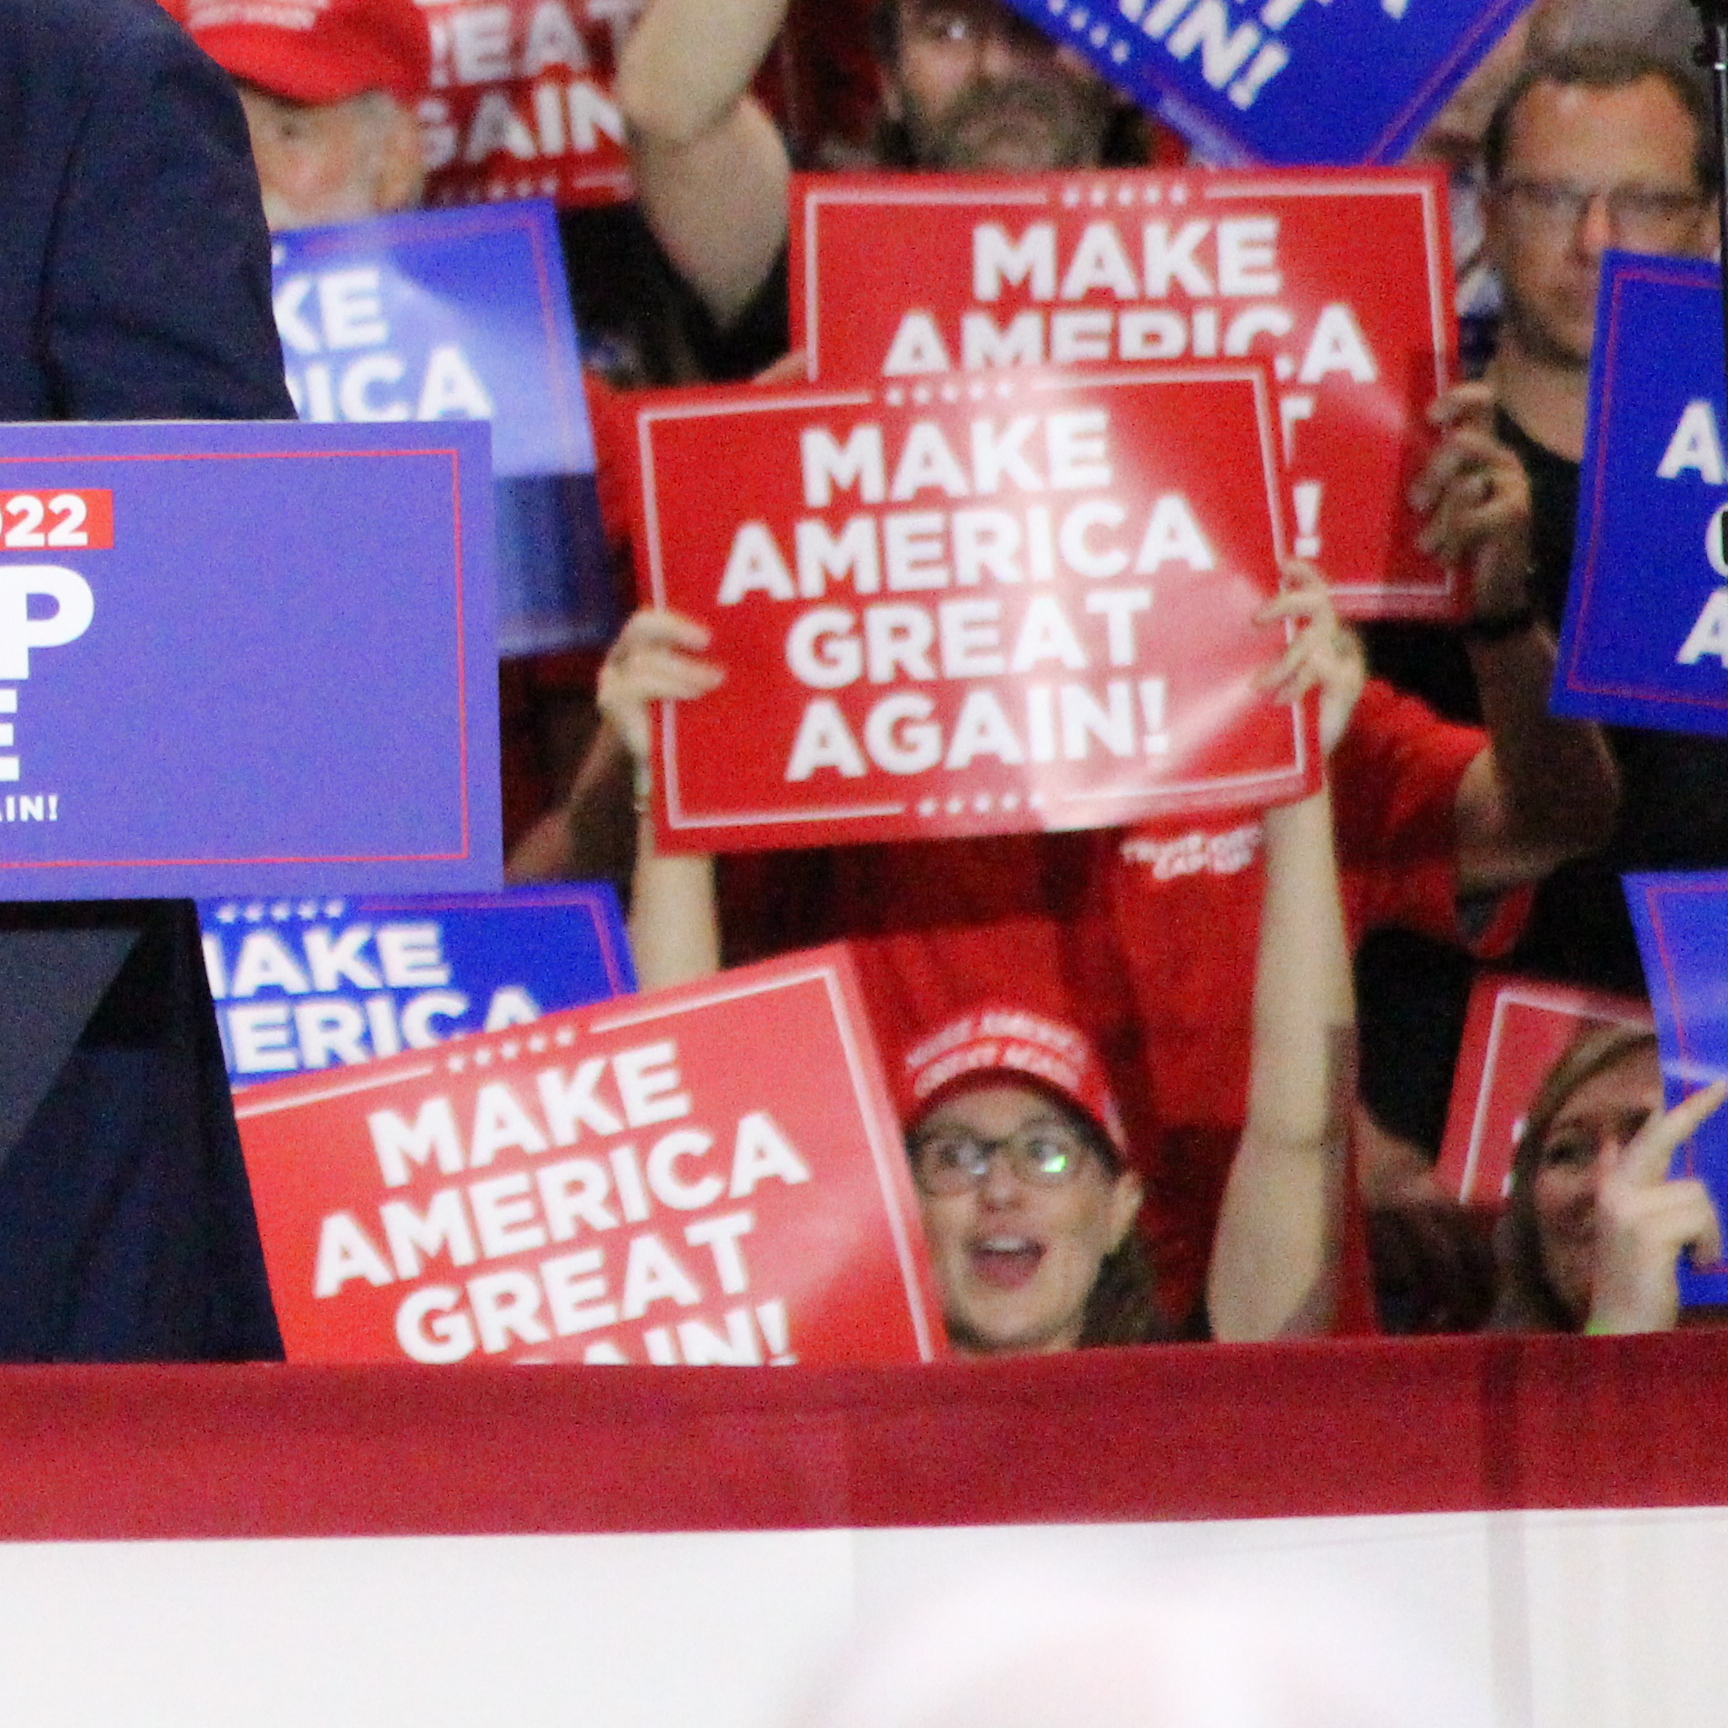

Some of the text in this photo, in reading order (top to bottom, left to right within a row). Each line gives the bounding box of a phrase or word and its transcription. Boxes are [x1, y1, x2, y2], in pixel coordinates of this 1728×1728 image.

[973, 215, 1283, 302] MAKE
[799, 407, 1112, 507] MAKE
[716, 492, 1217, 607] AMERICA
[784, 591, 1154, 689] GREAT
[784, 680, 1170, 784] AGAIN!
[366, 1039, 691, 1188] MAKE
[313, 1110, 811, 1299] AMERICA
[394, 1211, 754, 1365] GREAT
